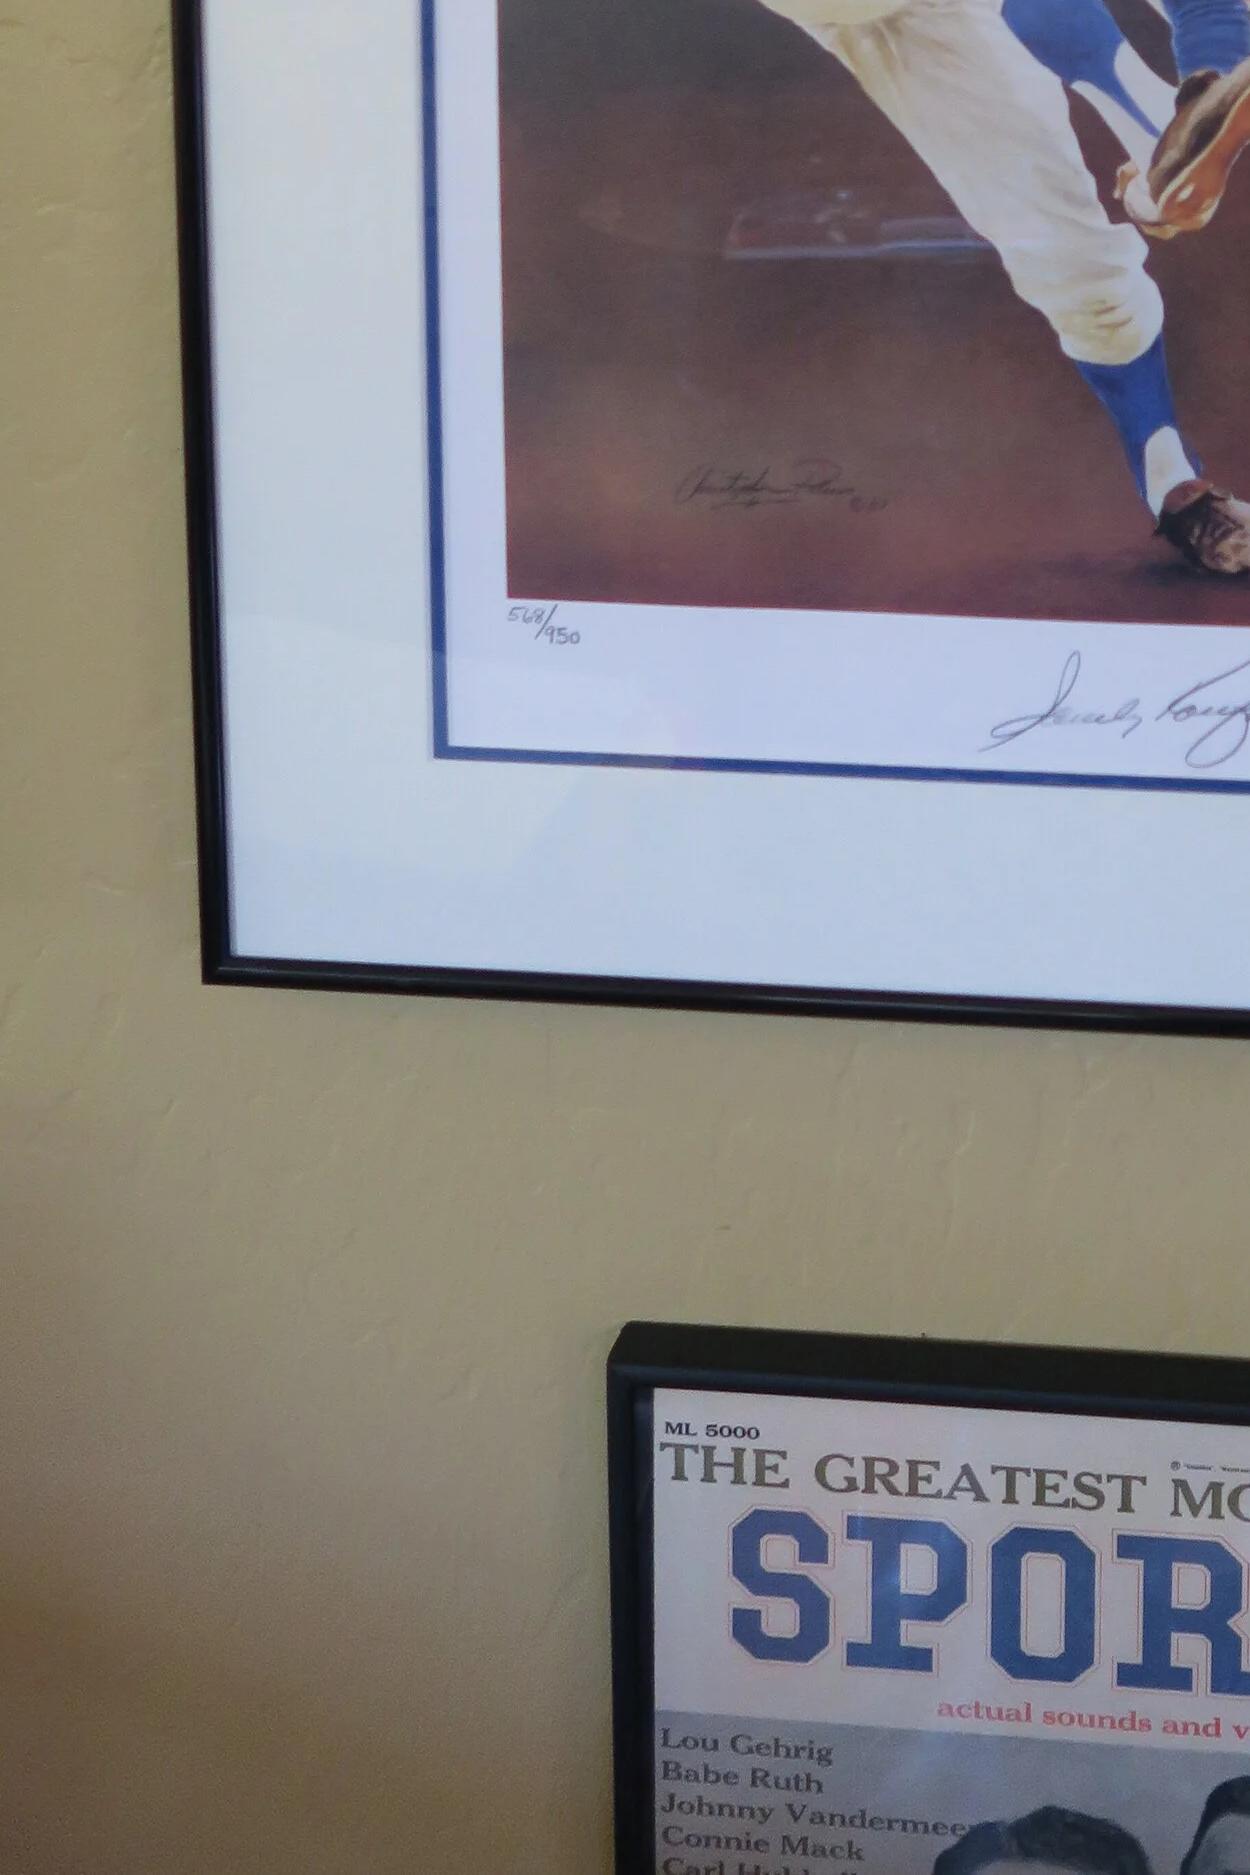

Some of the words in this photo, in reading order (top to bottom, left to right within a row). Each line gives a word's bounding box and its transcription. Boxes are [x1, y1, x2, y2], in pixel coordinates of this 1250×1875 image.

[664, 1421, 698, 1437] ML
[705, 1424, 760, 1440] 5000
[659, 1442, 790, 1489] THE
[814, 1453, 1148, 1513] GREATEST
[937, 1699, 1032, 1723] actual
[1042, 1704, 1152, 1733] sounds
[1162, 1716, 1222, 1739] and
[660, 1727, 719, 1752] Lou
[730, 1733, 834, 1767] Gehrig
[661, 1760, 740, 1786] Babe
[751, 1767, 824, 1794] Ruth
[660, 1792, 775, 1825] Johnny
[785, 1802, 978, 1837] Vandermee
[661, 1825, 771, 1854] Connie
[781, 1835, 865, 1862] Mack
